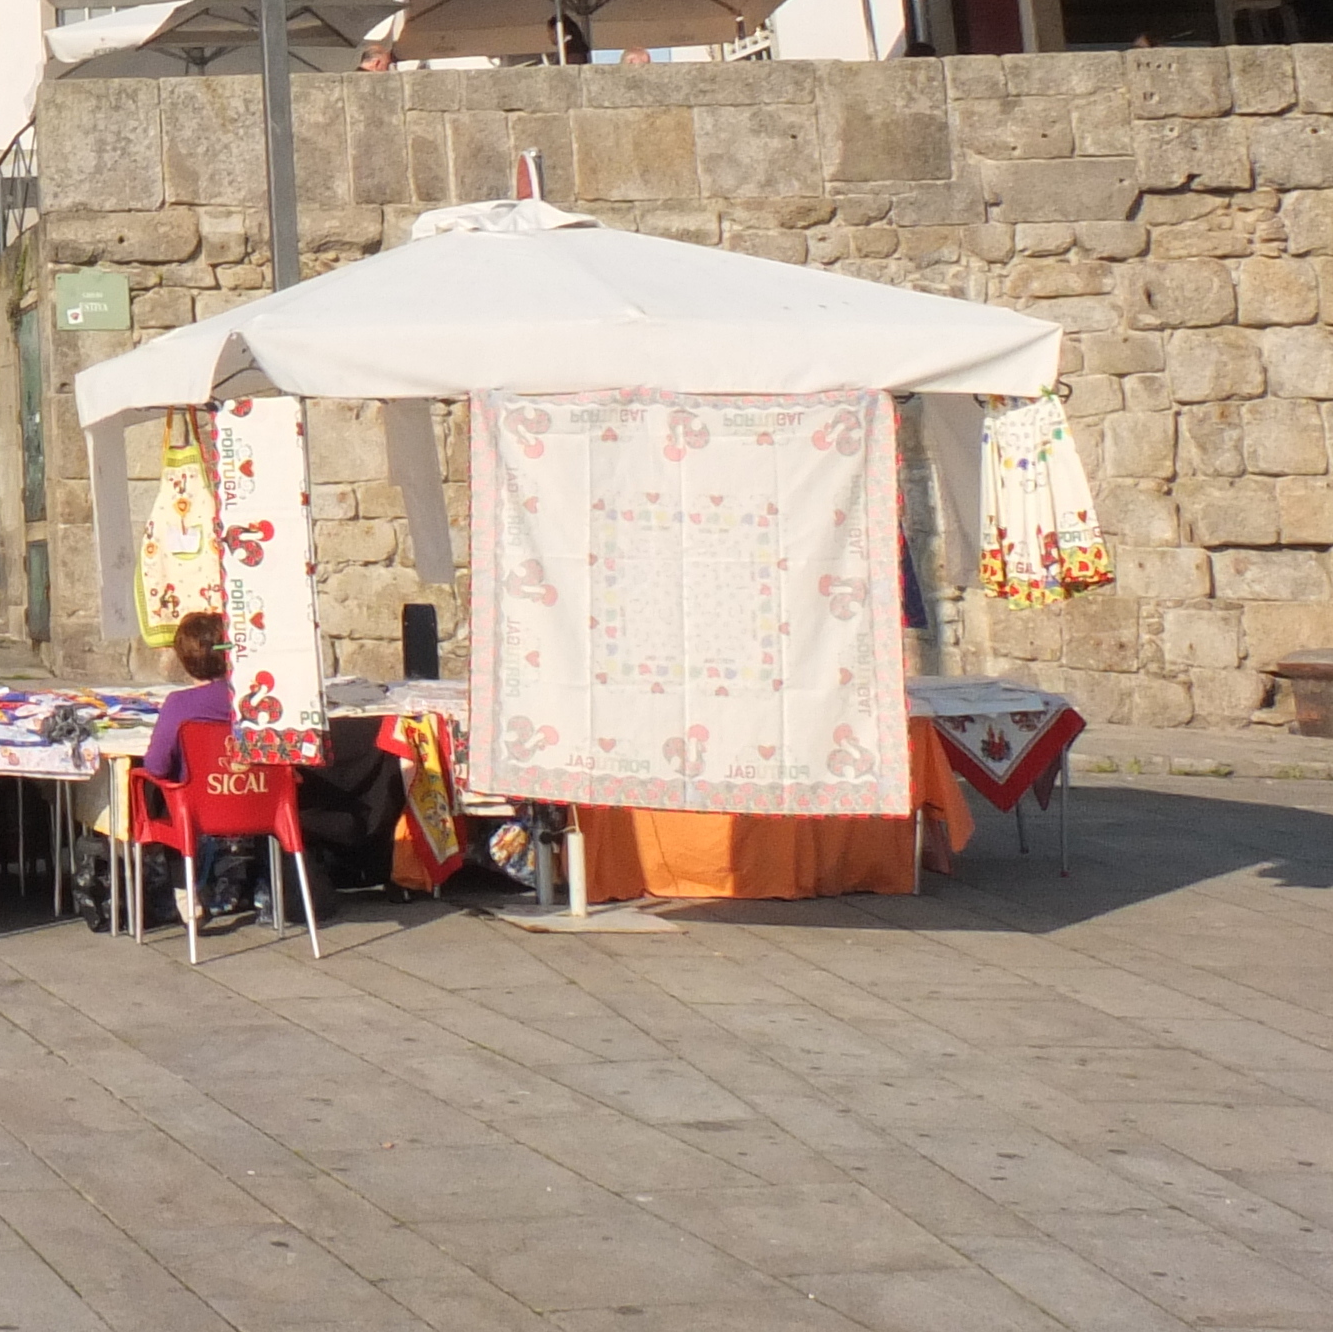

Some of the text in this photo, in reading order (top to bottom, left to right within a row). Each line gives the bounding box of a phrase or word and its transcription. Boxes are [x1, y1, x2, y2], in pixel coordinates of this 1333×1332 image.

[221, 427, 238, 511] PORTUGAL
[230, 579, 249, 663] PORTUGAL
[207, 771, 269, 795] SICAL
